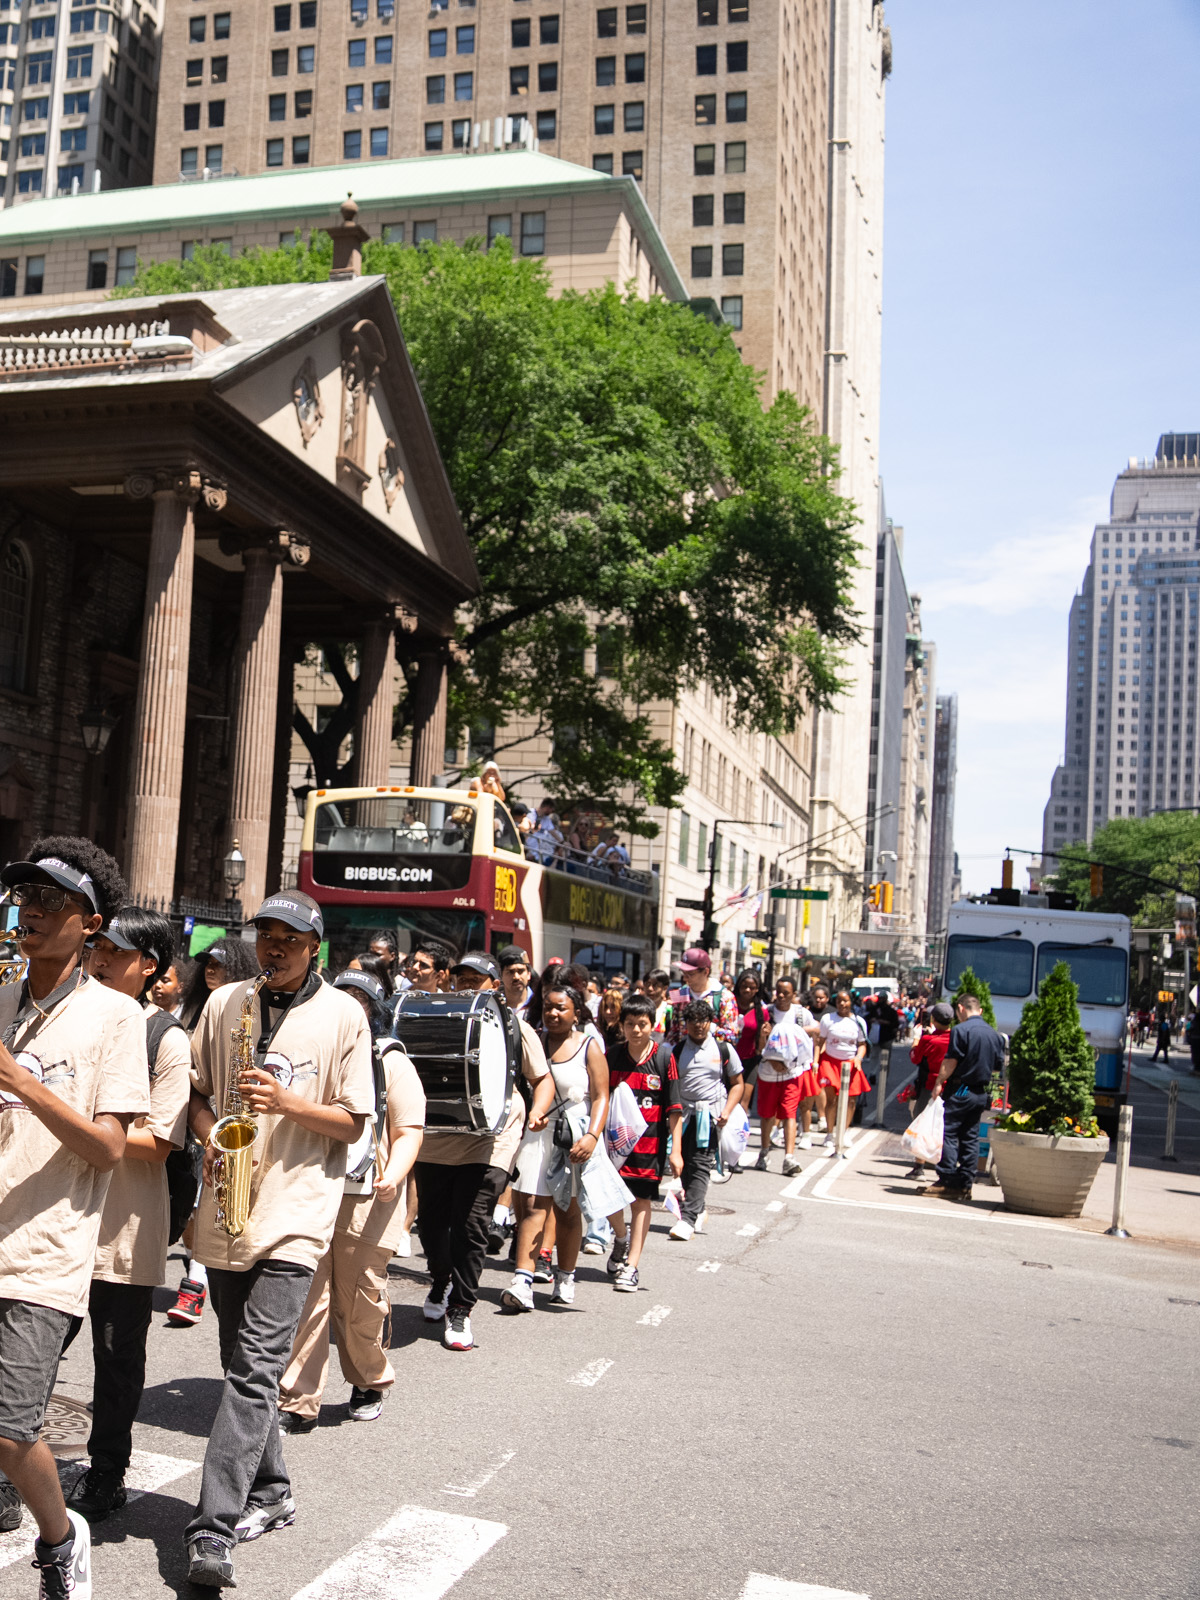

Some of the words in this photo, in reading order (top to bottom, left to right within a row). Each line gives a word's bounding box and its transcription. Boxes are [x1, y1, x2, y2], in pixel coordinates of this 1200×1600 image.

[344, 866, 433, 882] BIGBUS.COM
[266, 899, 299, 911] LIBERTY
[452, 897, 470, 907] ADL
